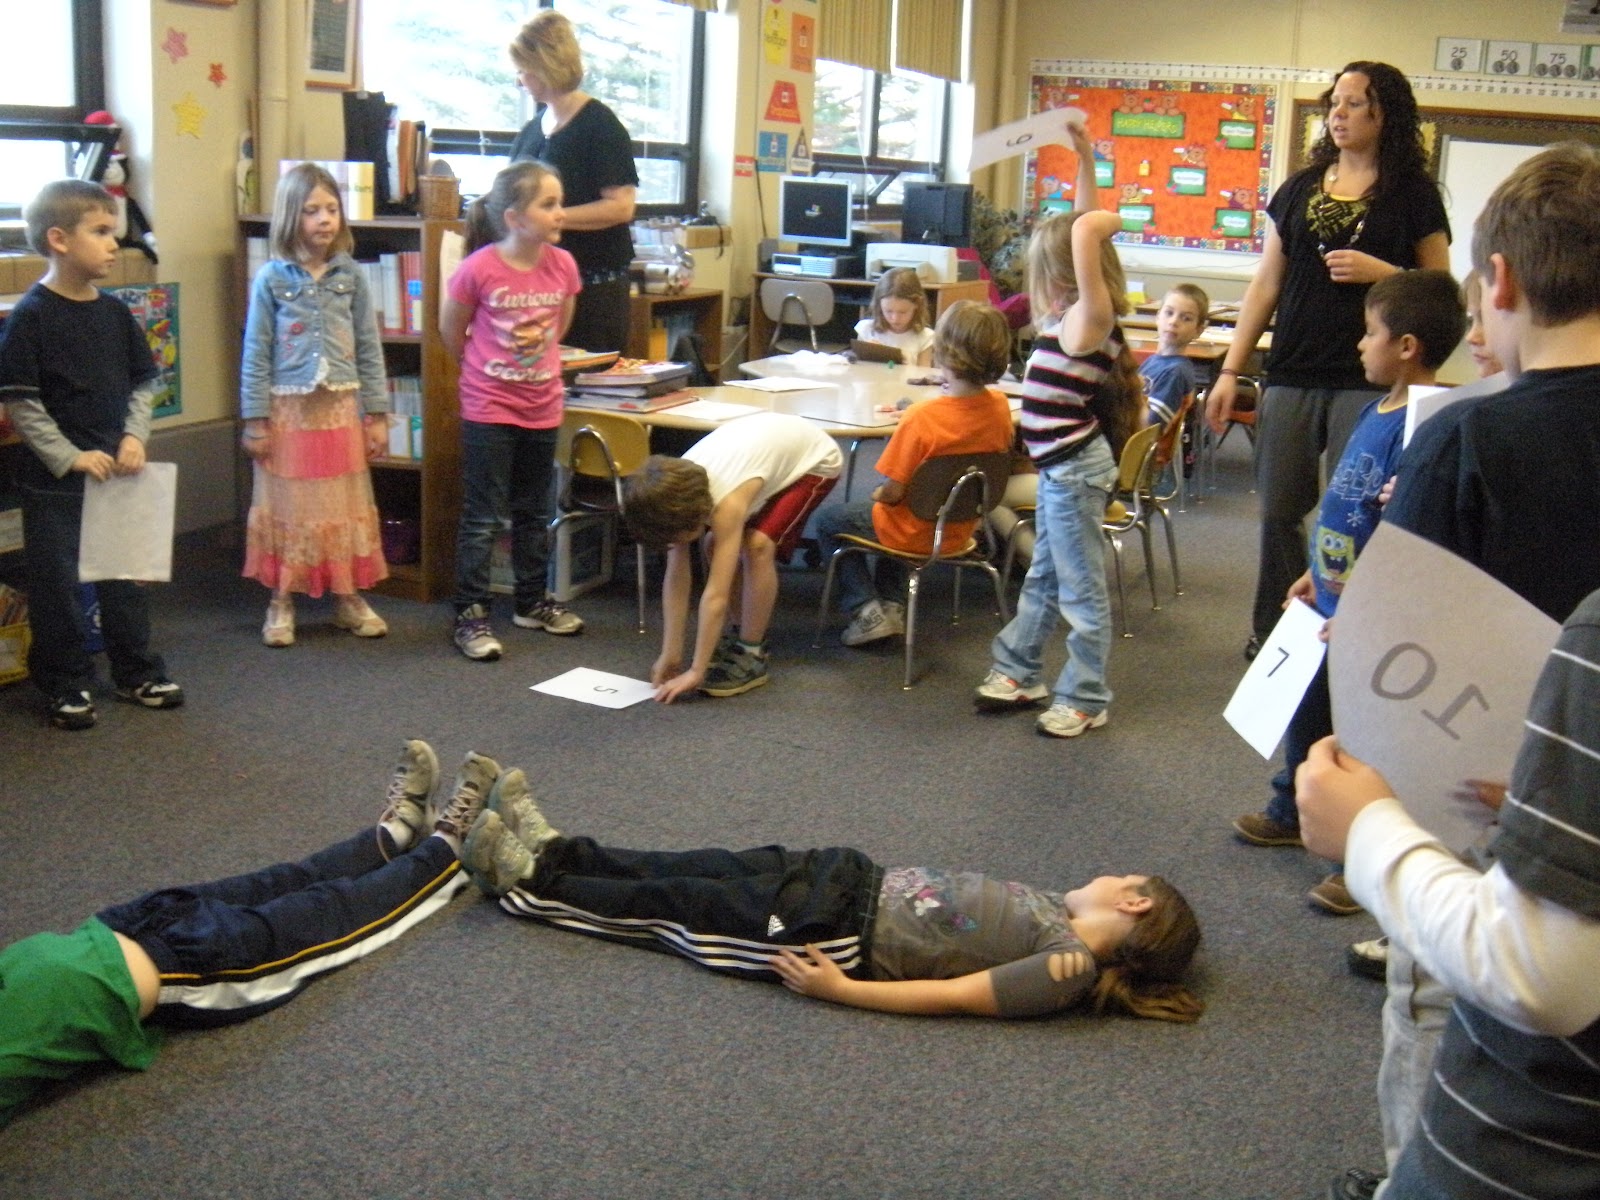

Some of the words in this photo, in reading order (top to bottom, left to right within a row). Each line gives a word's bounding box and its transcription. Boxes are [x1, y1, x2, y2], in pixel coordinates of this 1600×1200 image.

[1451, 46, 1468, 58] 25
[1500, 50, 1518, 62] 50
[1549, 53, 1567, 65] 75
[1267, 646, 1290, 678] 7
[593, 685, 618, 695] 5
